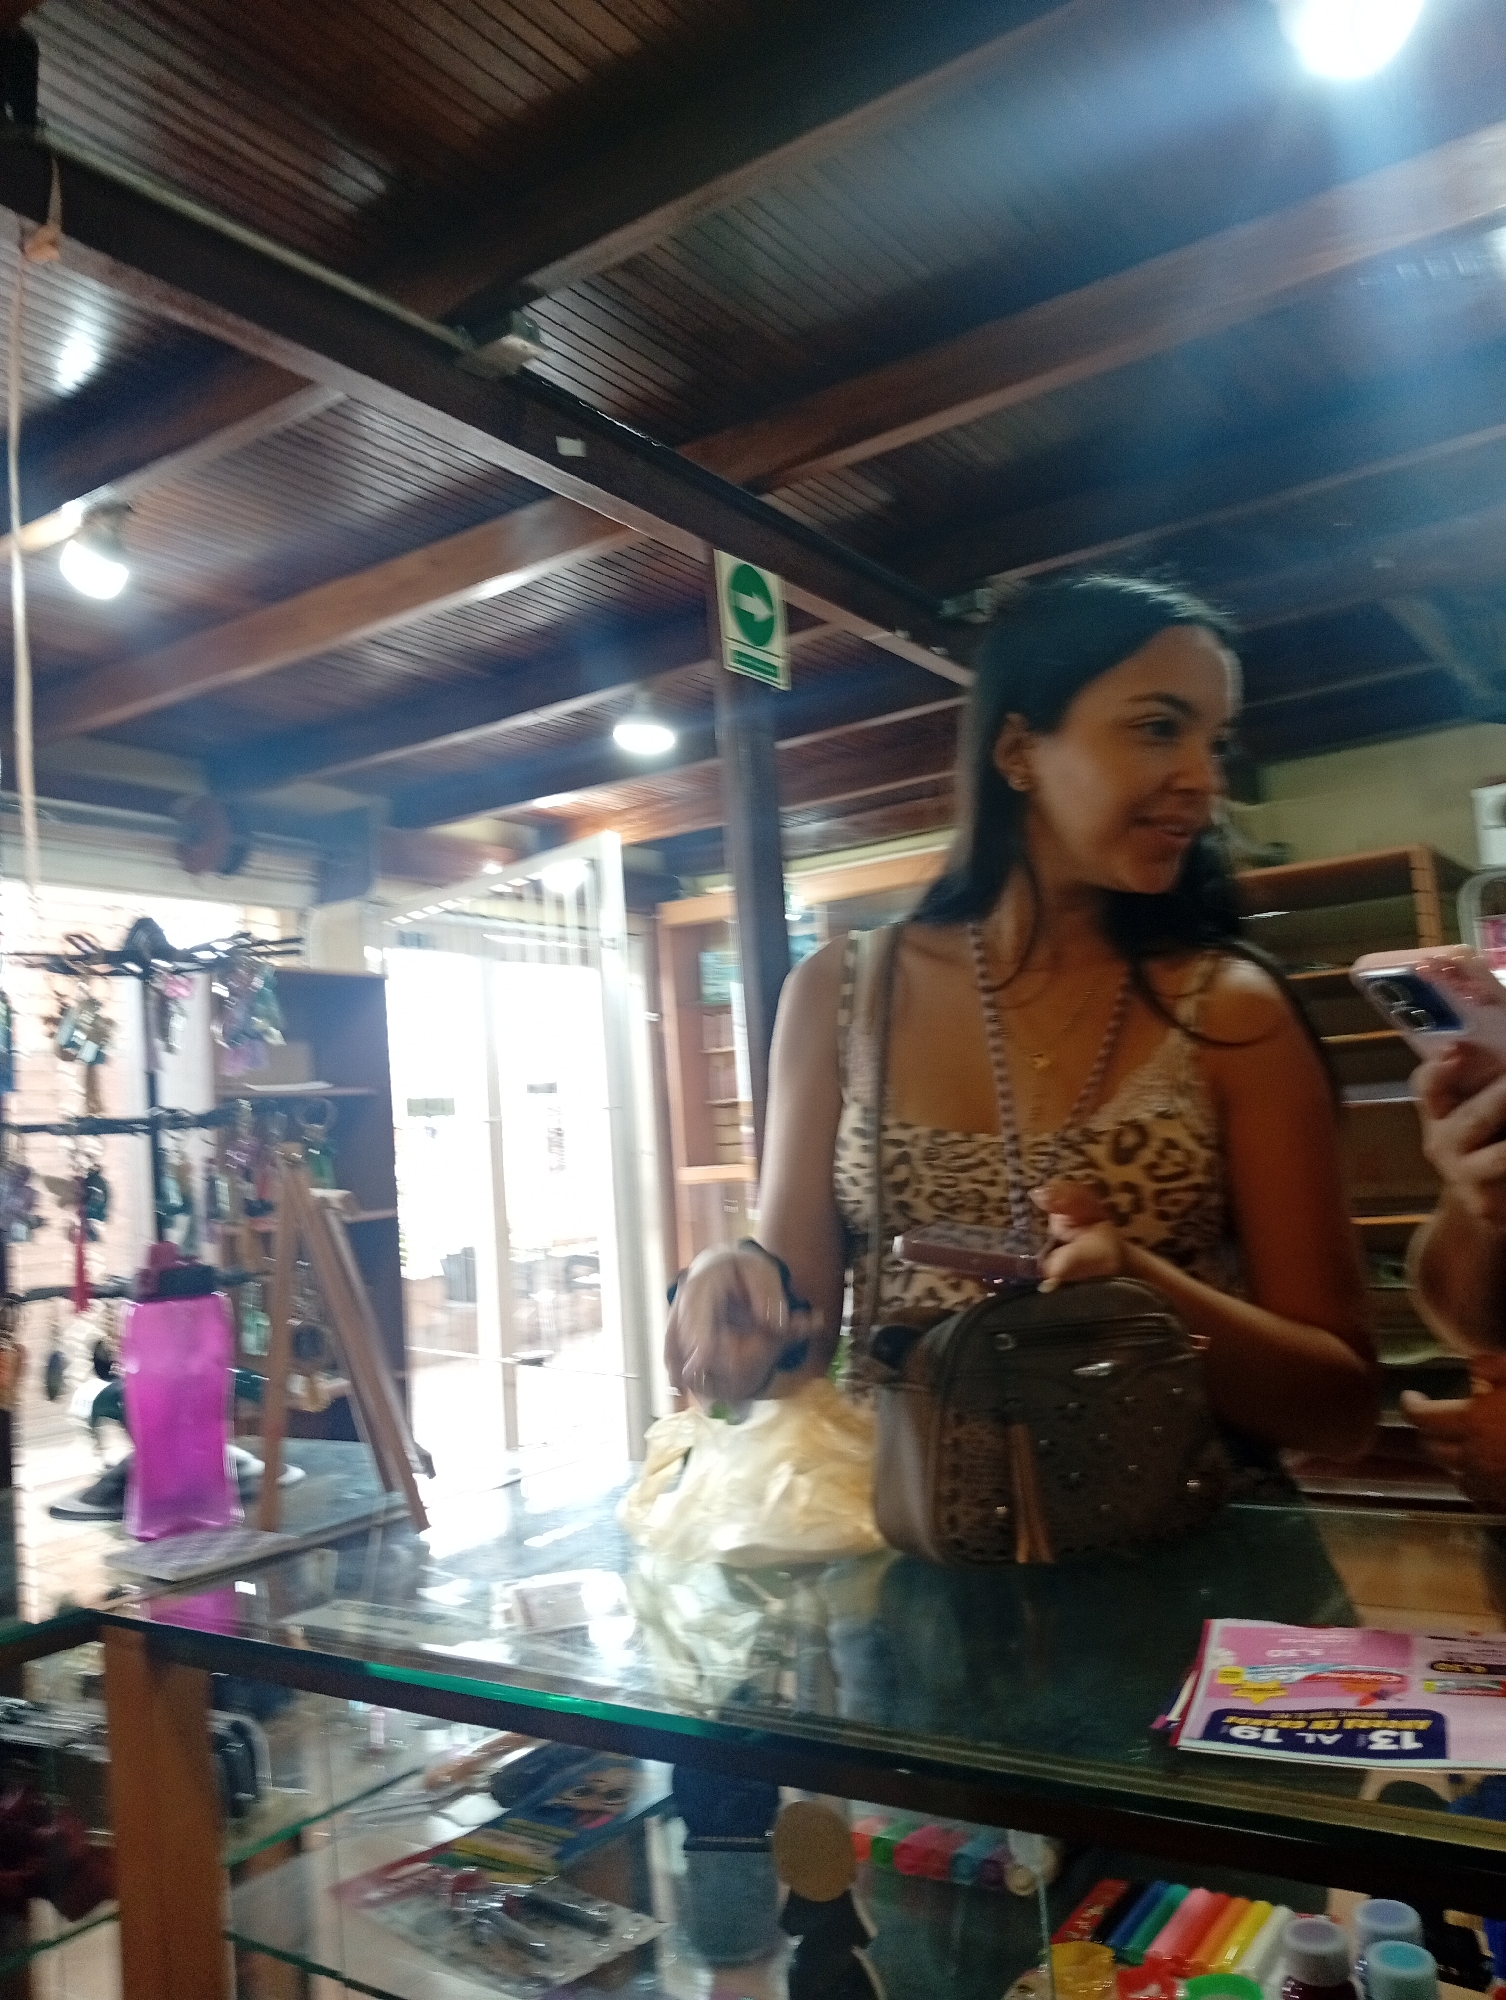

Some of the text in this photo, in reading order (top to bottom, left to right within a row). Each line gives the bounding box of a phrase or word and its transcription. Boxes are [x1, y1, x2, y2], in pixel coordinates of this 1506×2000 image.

[1228, 1725, 1284, 1743] 19
[1295, 1732, 1344, 1745] AL
[1367, 1729, 1424, 1751] 13
